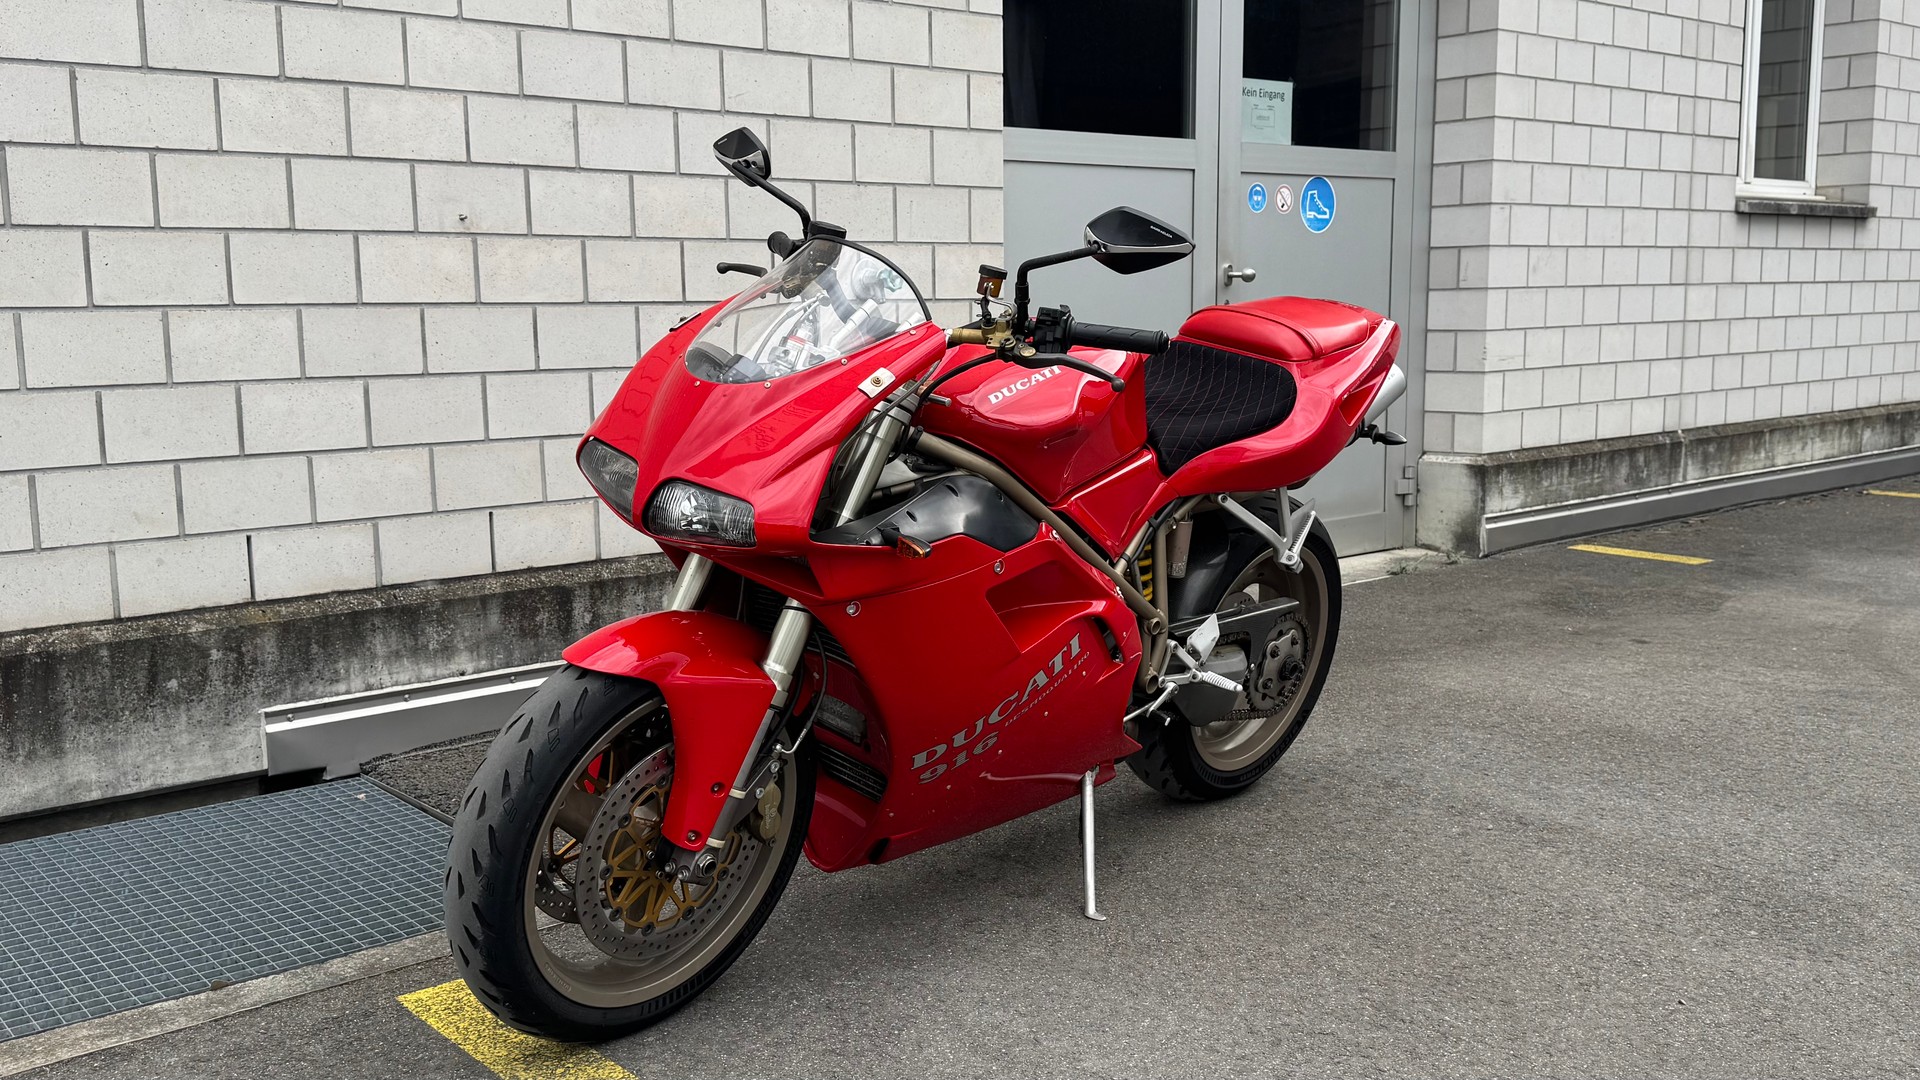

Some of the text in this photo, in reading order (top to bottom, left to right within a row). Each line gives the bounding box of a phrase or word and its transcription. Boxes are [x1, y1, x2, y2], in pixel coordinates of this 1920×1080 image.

[1242, 86, 1285, 102] Kein Eingang
[987, 365, 1061, 404] DUCATI
[911, 633, 1082, 770] DUCATI
[918, 731, 999, 784] 916
